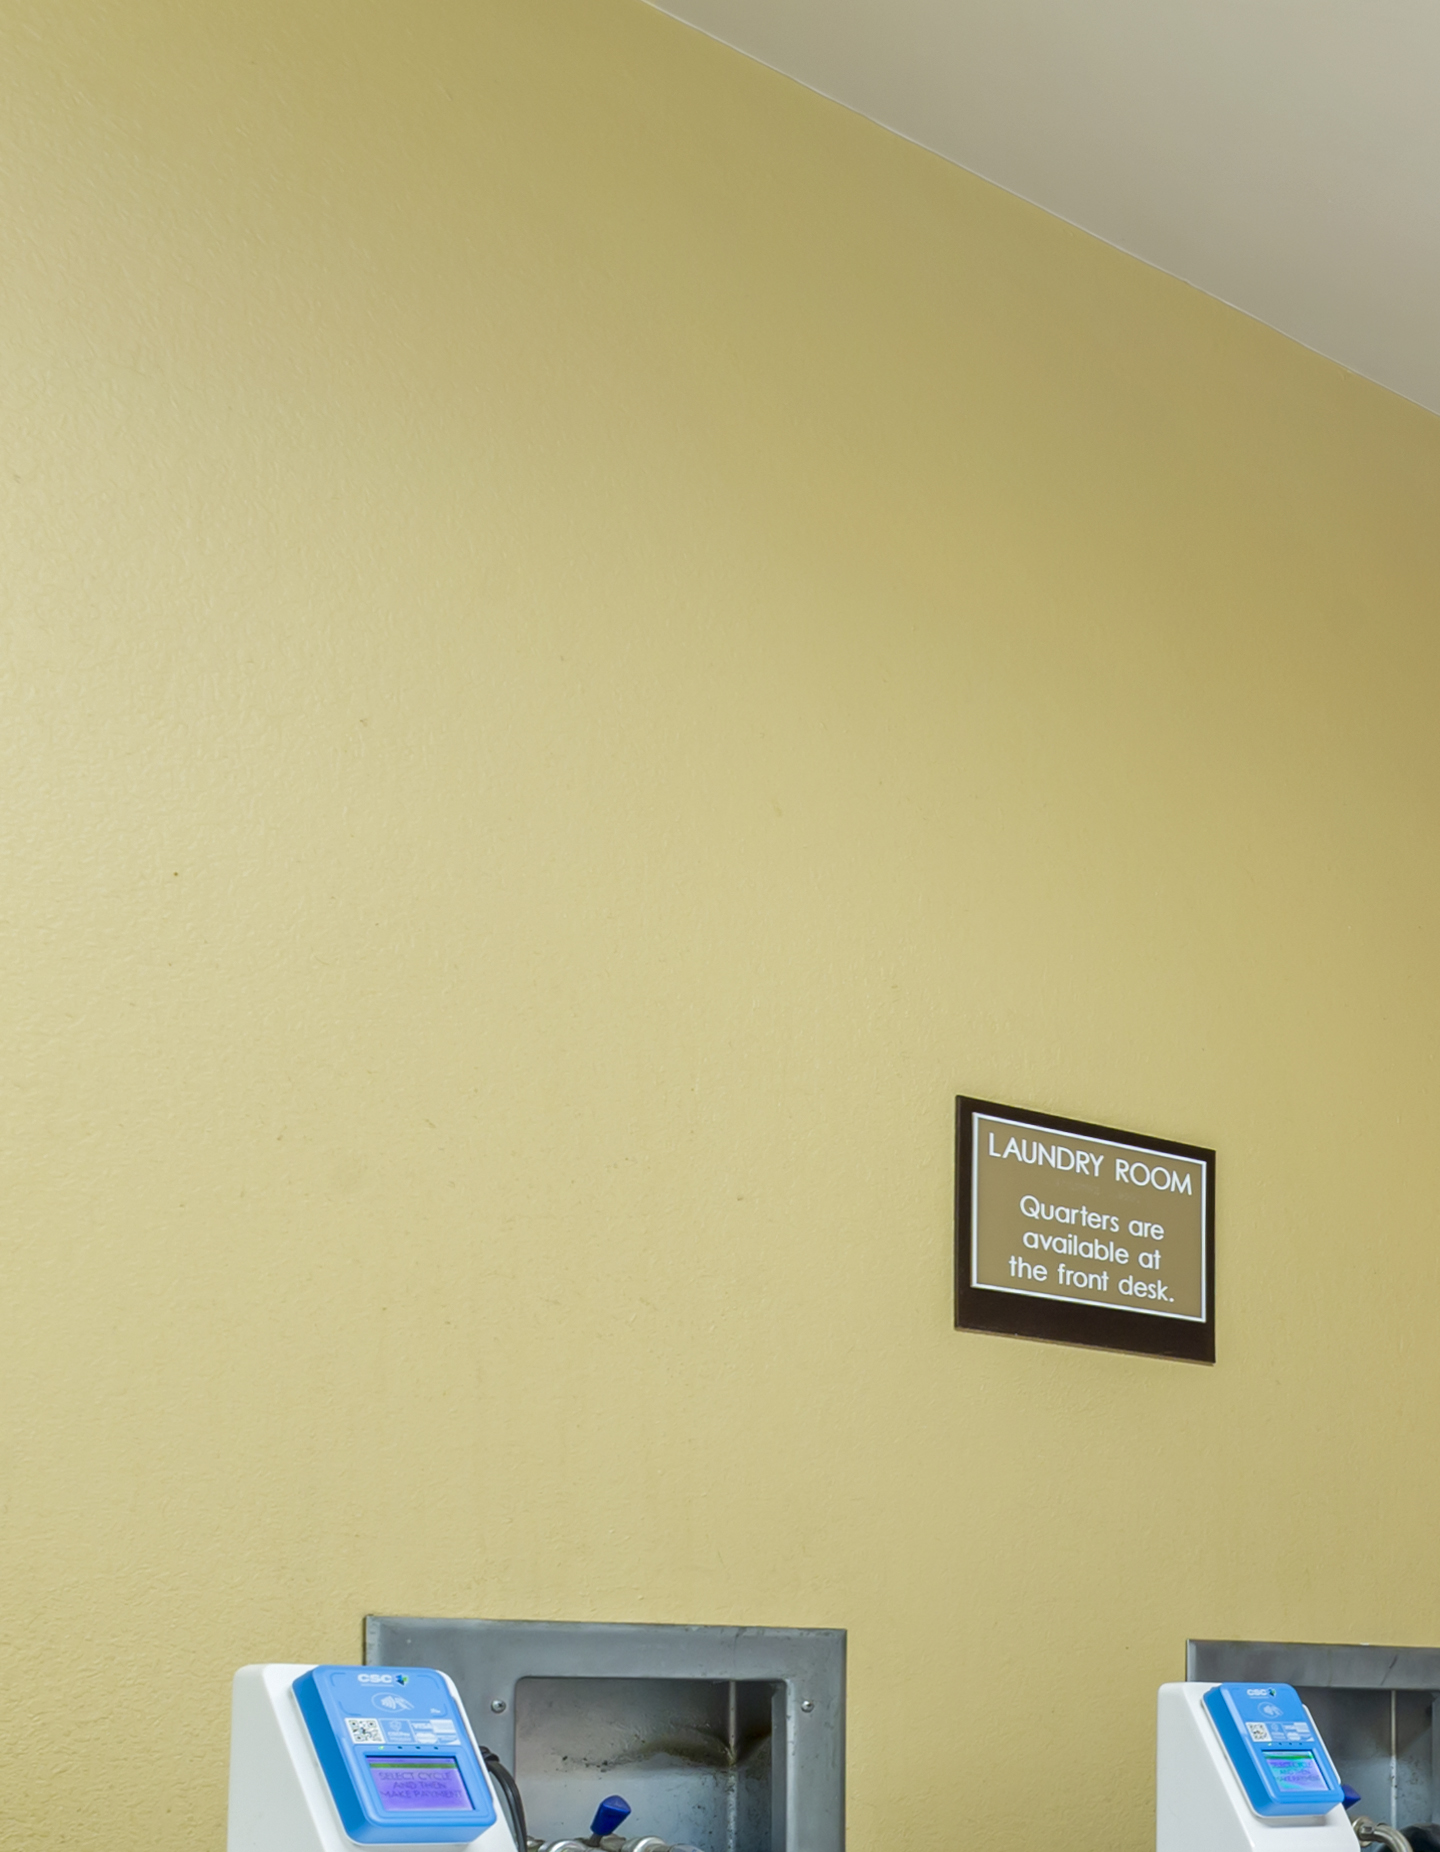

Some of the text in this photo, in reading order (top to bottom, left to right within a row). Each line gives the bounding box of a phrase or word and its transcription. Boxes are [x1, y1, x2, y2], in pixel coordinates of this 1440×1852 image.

[989, 1132, 1192, 1196] LAUNDRY ROOM
[1019, 1195, 1165, 1240] Quarters are
[1022, 1231, 1161, 1270] available at
[1008, 1255, 1175, 1303] the front desk.
[357, 1673, 393, 1684] CSC
[378, 1772, 453, 1781] SELECT CYCLE
[392, 1781, 447, 1789] AND THEN
[379, 1790, 462, 1798] MAKE PAYMENT
